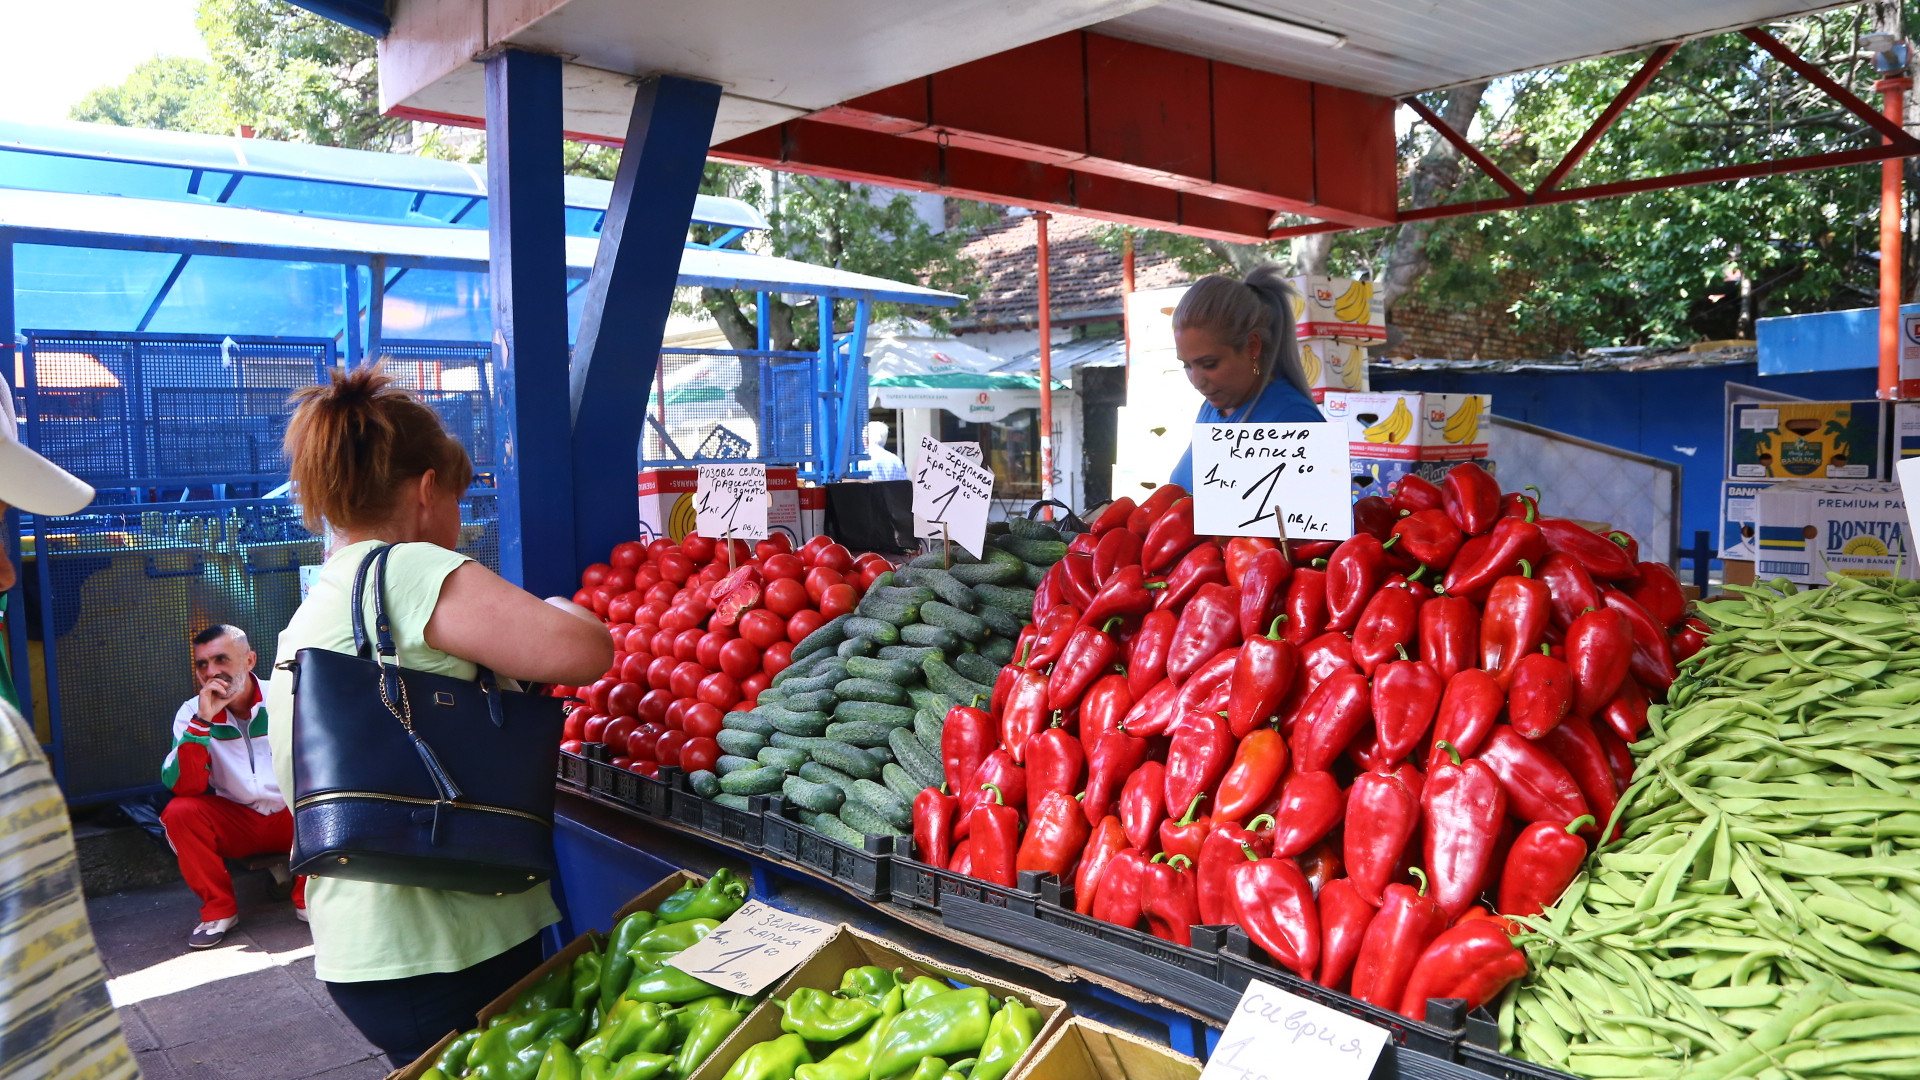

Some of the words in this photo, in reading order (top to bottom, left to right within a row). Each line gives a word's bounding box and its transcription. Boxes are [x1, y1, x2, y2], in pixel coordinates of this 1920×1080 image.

[1329, 400, 1347, 410] Dole
[1431, 410, 1445, 421] Dole
[1298, 465, 1314, 473] 60
[1818, 499, 1879, 509] PREMIUM
[1884, 500, 1907, 510] PAC
[1827, 520, 1907, 553] BONITA
[1826, 556, 1864, 564] PREMIUM
[1866, 557, 1907, 565] BANANS
